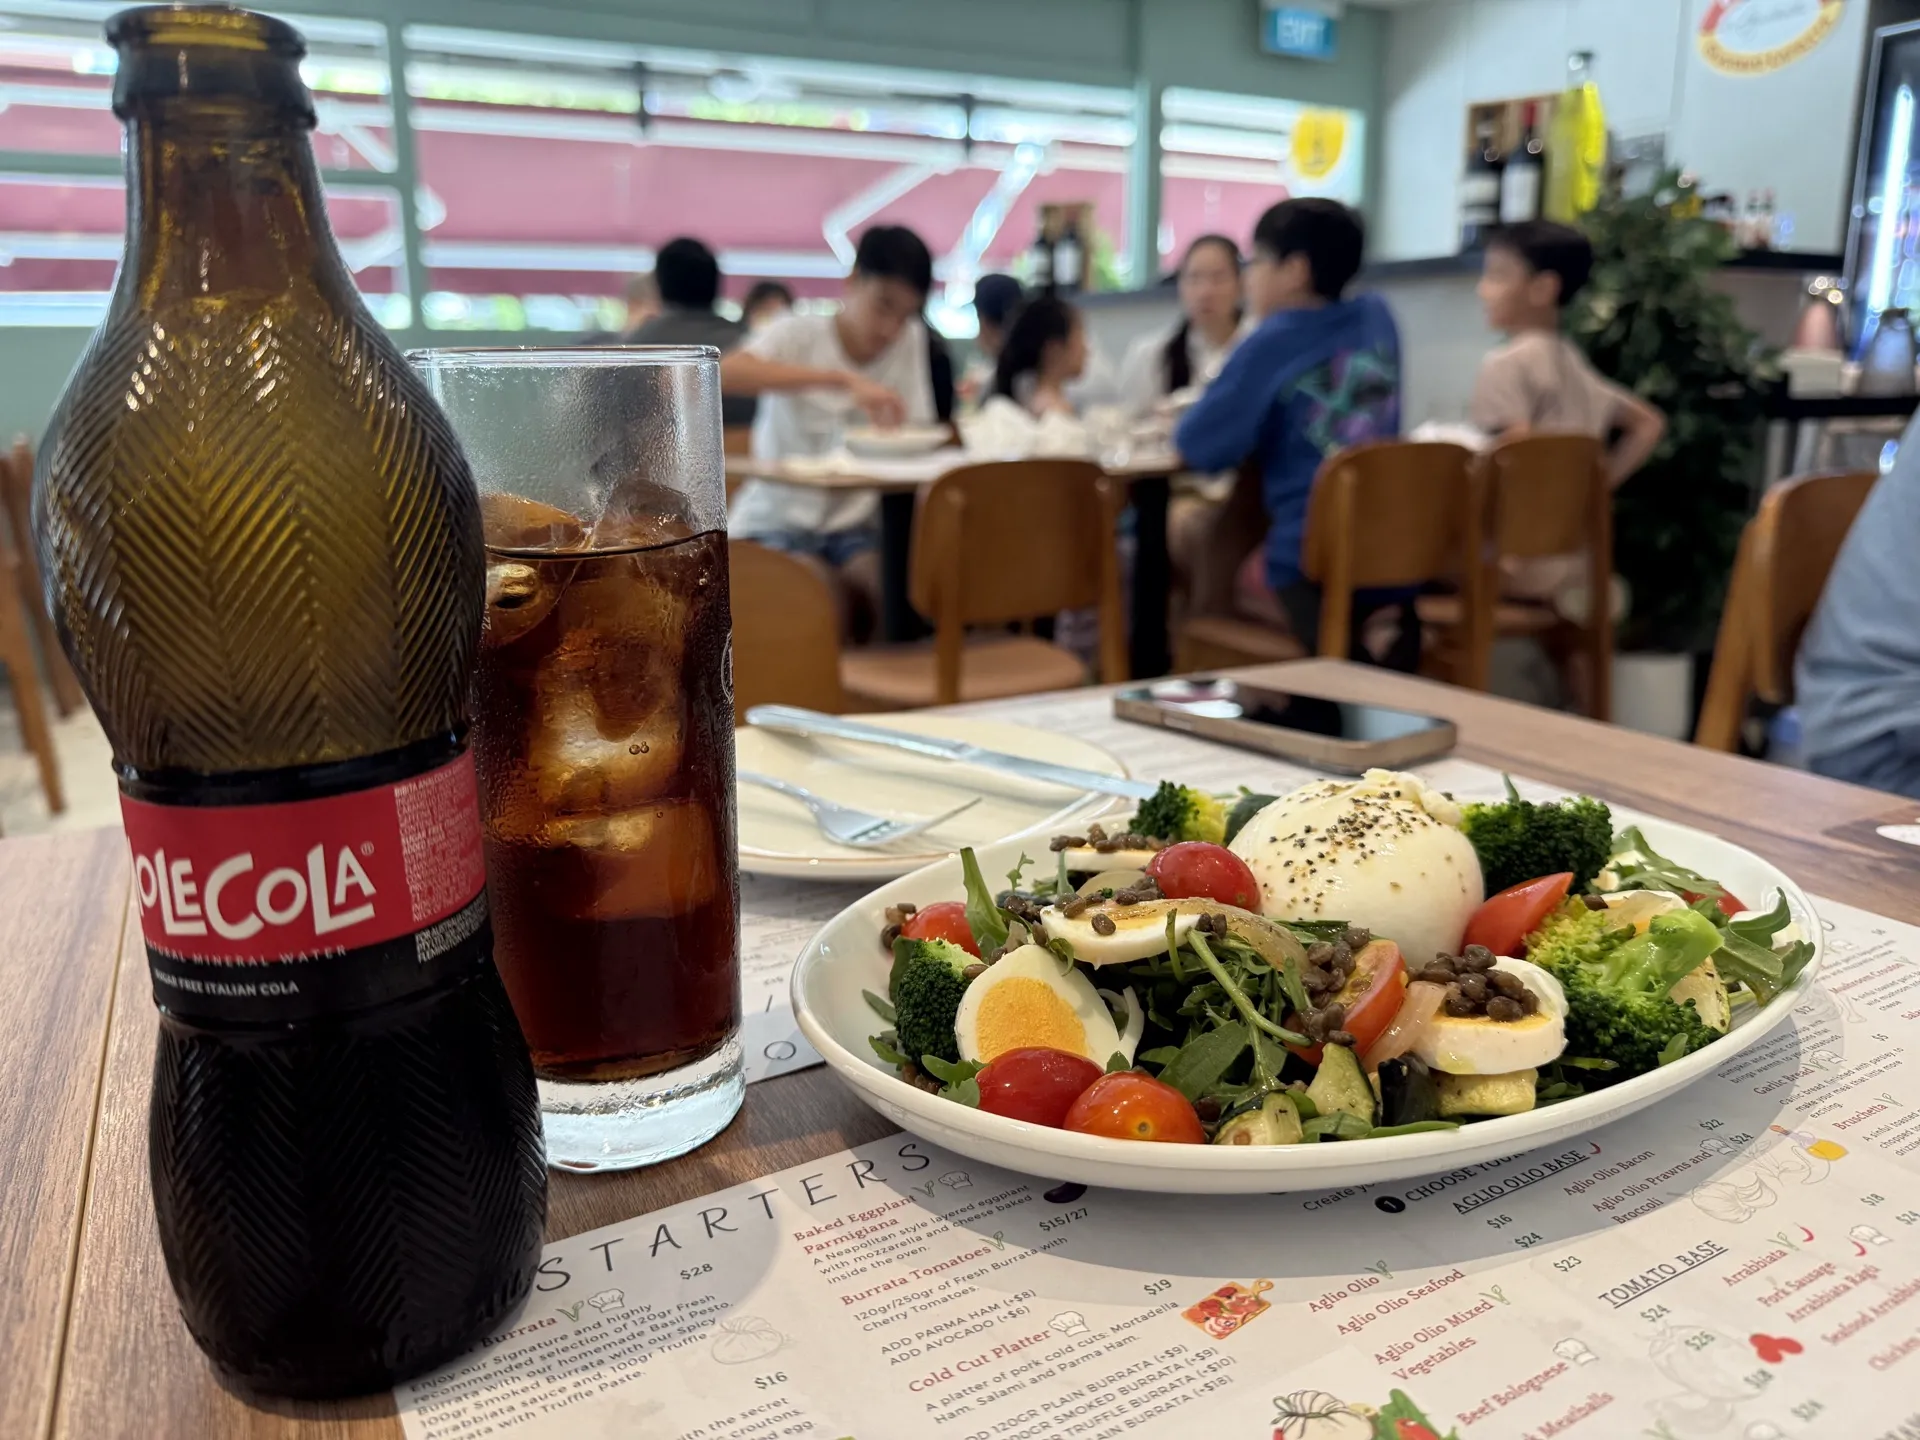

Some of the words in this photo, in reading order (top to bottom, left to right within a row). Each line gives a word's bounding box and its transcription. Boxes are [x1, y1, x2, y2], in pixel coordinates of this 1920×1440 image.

[193, 952, 270, 967] MINERAL
[280, 944, 348, 965] WATER
[178, 977, 204, 994] FREE
[205, 980, 257, 997] ITALIAN
[259, 980, 300, 996] COLA
[1718, 1061, 1752, 1079] pumpkin
[1753, 1076, 1788, 1095] Garlic
[1782, 1066, 1815, 1083] Bread
[1779, 1090, 1805, 1106] Garlic
[1855, 1061, 1871, 1072] with
[1795, 1099, 1818, 1112] make
[1817, 1092, 1834, 1104] your
[1833, 1082, 1853, 1095] meal
[1850, 1075, 1868, 1087] that
[1866, 1067, 1886, 1080] little
[1700, 1118, 1725, 1132] $22
[1729, 1131, 1755, 1146] $24
[1832, 1102, 1889, 1131] Bruschetta
[1870, 1124, 1892, 1139] sinful
[1889, 1112, 1919, 1129] toasted
[1879, 1128, 1913, 1150] chopped
[1404, 1165, 1479, 1203] CHOOSE
[1452, 1184, 1505, 1214] AGLIO
[1503, 1168, 1545, 1190] OLIO
[1541, 1149, 1587, 1172] BASE
[1562, 1175, 1596, 1196] Aglio
[1592, 1164, 1621, 1182] Olio
[1620, 1149, 1656, 1171] Bacon
[1591, 1192, 1626, 1214] Aglio
[1621, 1181, 1651, 1198] Olio
[1644, 1160, 1693, 1187] Prawns
[1690, 1148, 1714, 1166] and
[535, 1143, 931, 1292] STARTERS
[792, 1217, 846, 1242] Baked
[847, 1194, 918, 1224] Eggplant
[1038, 1207, 1090, 1233] $15/27
[1302, 1187, 1356, 1211] Create
[1610, 1196, 1665, 1225] Broccoli
[1859, 1192, 1887, 1208] $18
[802, 1217, 901, 1255] Parmigiana
[818, 1259, 850, 1275] with
[853, 1235, 924, 1263] mozzarella
[924, 1224, 951, 1239] and
[951, 1208, 995, 1229] cheese
[995, 1194, 1034, 1213] baked
[825, 1231, 897, 1261] Neapolitan
[899, 1221, 929, 1237] style
[930, 1203, 976, 1225] layered
[977, 1184, 1031, 1208] eggplant
[1485, 1213, 1514, 1230] $16
[1514, 1231, 1545, 1249] $24
[679, 1262, 714, 1281] $28
[826, 1264, 869, 1285] inside
[870, 1254, 894, 1270] the
[896, 1246, 931, 1261] oven.
[839, 1276, 910, 1307] Burrata
[908, 1245, 993, 1281] Tomatoes
[853, 1286, 935, 1322] 120gr/250gr
[952, 1267, 990, 1286] Fresh
[990, 1247, 1039, 1271] Burrata
[1041, 1235, 1070, 1251] with
[1552, 1255, 1582, 1273] $23
[1597, 1262, 1679, 1307] TOMATO
[1673, 1239, 1726, 1268] BASE
[1721, 1248, 1790, 1288] Arrabbiata
[1756, 1286, 1793, 1308] Pork
[1784, 1261, 1837, 1292] Sausage
[861, 1311, 909, 1334] Cherry
[909, 1285, 981, 1315] Tomatoes.
[1142, 1278, 1174, 1297] $19
[1307, 1289, 1349, 1313] Aglio
[1346, 1275, 1381, 1294] Olio
[1336, 1309, 1378, 1336] Aglio
[1374, 1296, 1410, 1316] Olio
[1406, 1268, 1467, 1301] Seafood
[1785, 1280, 1852, 1324] Arrabbiata
[480, 1315, 558, 1349] Burrata
[880, 1336, 913, 1356] ADD
[914, 1315, 969, 1342] PARMA
[967, 1302, 1003, 1320] HAM
[1373, 1338, 1416, 1366] Aglio
[1412, 1323, 1449, 1345] Olio
[1443, 1298, 1495, 1329] Mixed
[1639, 1303, 1673, 1323] $24
[410, 1372, 456, 1394] Enjoy
[459, 1361, 489, 1377] our
[492, 1332, 570, 1367] Signature
[573, 1320, 603, 1338] and
[606, 1303, 652, 1326] highly
[412, 1356, 536, 1404] recommended
[539, 1329, 611, 1362] selection
[632, 1307, 674, 1329] 120gr
[675, 1293, 717, 1312] Fresh
[889, 1347, 923, 1367] ADD
[925, 1318, 995, 1352] AVOCADO
[907, 1365, 956, 1393] Cold
[955, 1352, 991, 1374] Cut
[990, 1328, 1052, 1360] Platter
[939, 1378, 990, 1408] platter
[991, 1370, 1009, 1384] of
[1010, 1357, 1044, 1380] pork
[1043, 1342, 1076, 1363] cold
[1076, 1330, 1110, 1350] cuts:
[1108, 1299, 1180, 1336] Mortadella
[1390, 1334, 1479, 1381] Vegetables
[416, 1388, 481, 1417] Burrata
[484, 1373, 522, 1394] with
[526, 1363, 553, 1379] our
[557, 1328, 646, 1369] homemade
[649, 1313, 686, 1334] Basil
[418, 1405, 469, 1430] 100gr
[473, 1380, 543, 1411] Smoked
[545, 1356, 606, 1386] Burrata
[608, 1341, 644, 1361] with
[646, 1331, 673, 1346] our
[676, 1316, 717, 1336] Spicy
[424, 1405, 517, 1440] Arrabbiata
[521, 1384, 568, 1408] sauce
[609, 1351, 655, 1374] 100gr
[657, 1332, 708, 1355] Truffle
[753, 1370, 790, 1391] $16
[976, 1378, 1028, 1408] Salami
[1029, 1367, 1057, 1386] and
[1057, 1348, 1103, 1373] Parma
[1103, 1334, 1142, 1354] Ham.
[498, 1411, 537, 1430] with
[540, 1388, 595, 1416] Truffle
[707, 1415, 737, 1432] the
[738, 1396, 790, 1420] secret
[991, 1407, 1041, 1434] 120GR
[1040, 1387, 1087, 1413] PLAIN
[1086, 1358, 1155, 1394] BURRATA
[1052, 1391, 1117, 1425] SMOKED
[1116, 1361, 1187, 1396] BURRATA
[1063, 1402, 1130, 1437] TRUFFLE
[1127, 1373, 1198, 1409] BURRATA
[1123, 1393, 1195, 1429] BURRATA
[1456, 1397, 1497, 1427] Beef
[1491, 1360, 1570, 1408] Bolognese
[729, 1406, 806, 1440] croutons.
[782, 1419, 819, 1436] egg.
